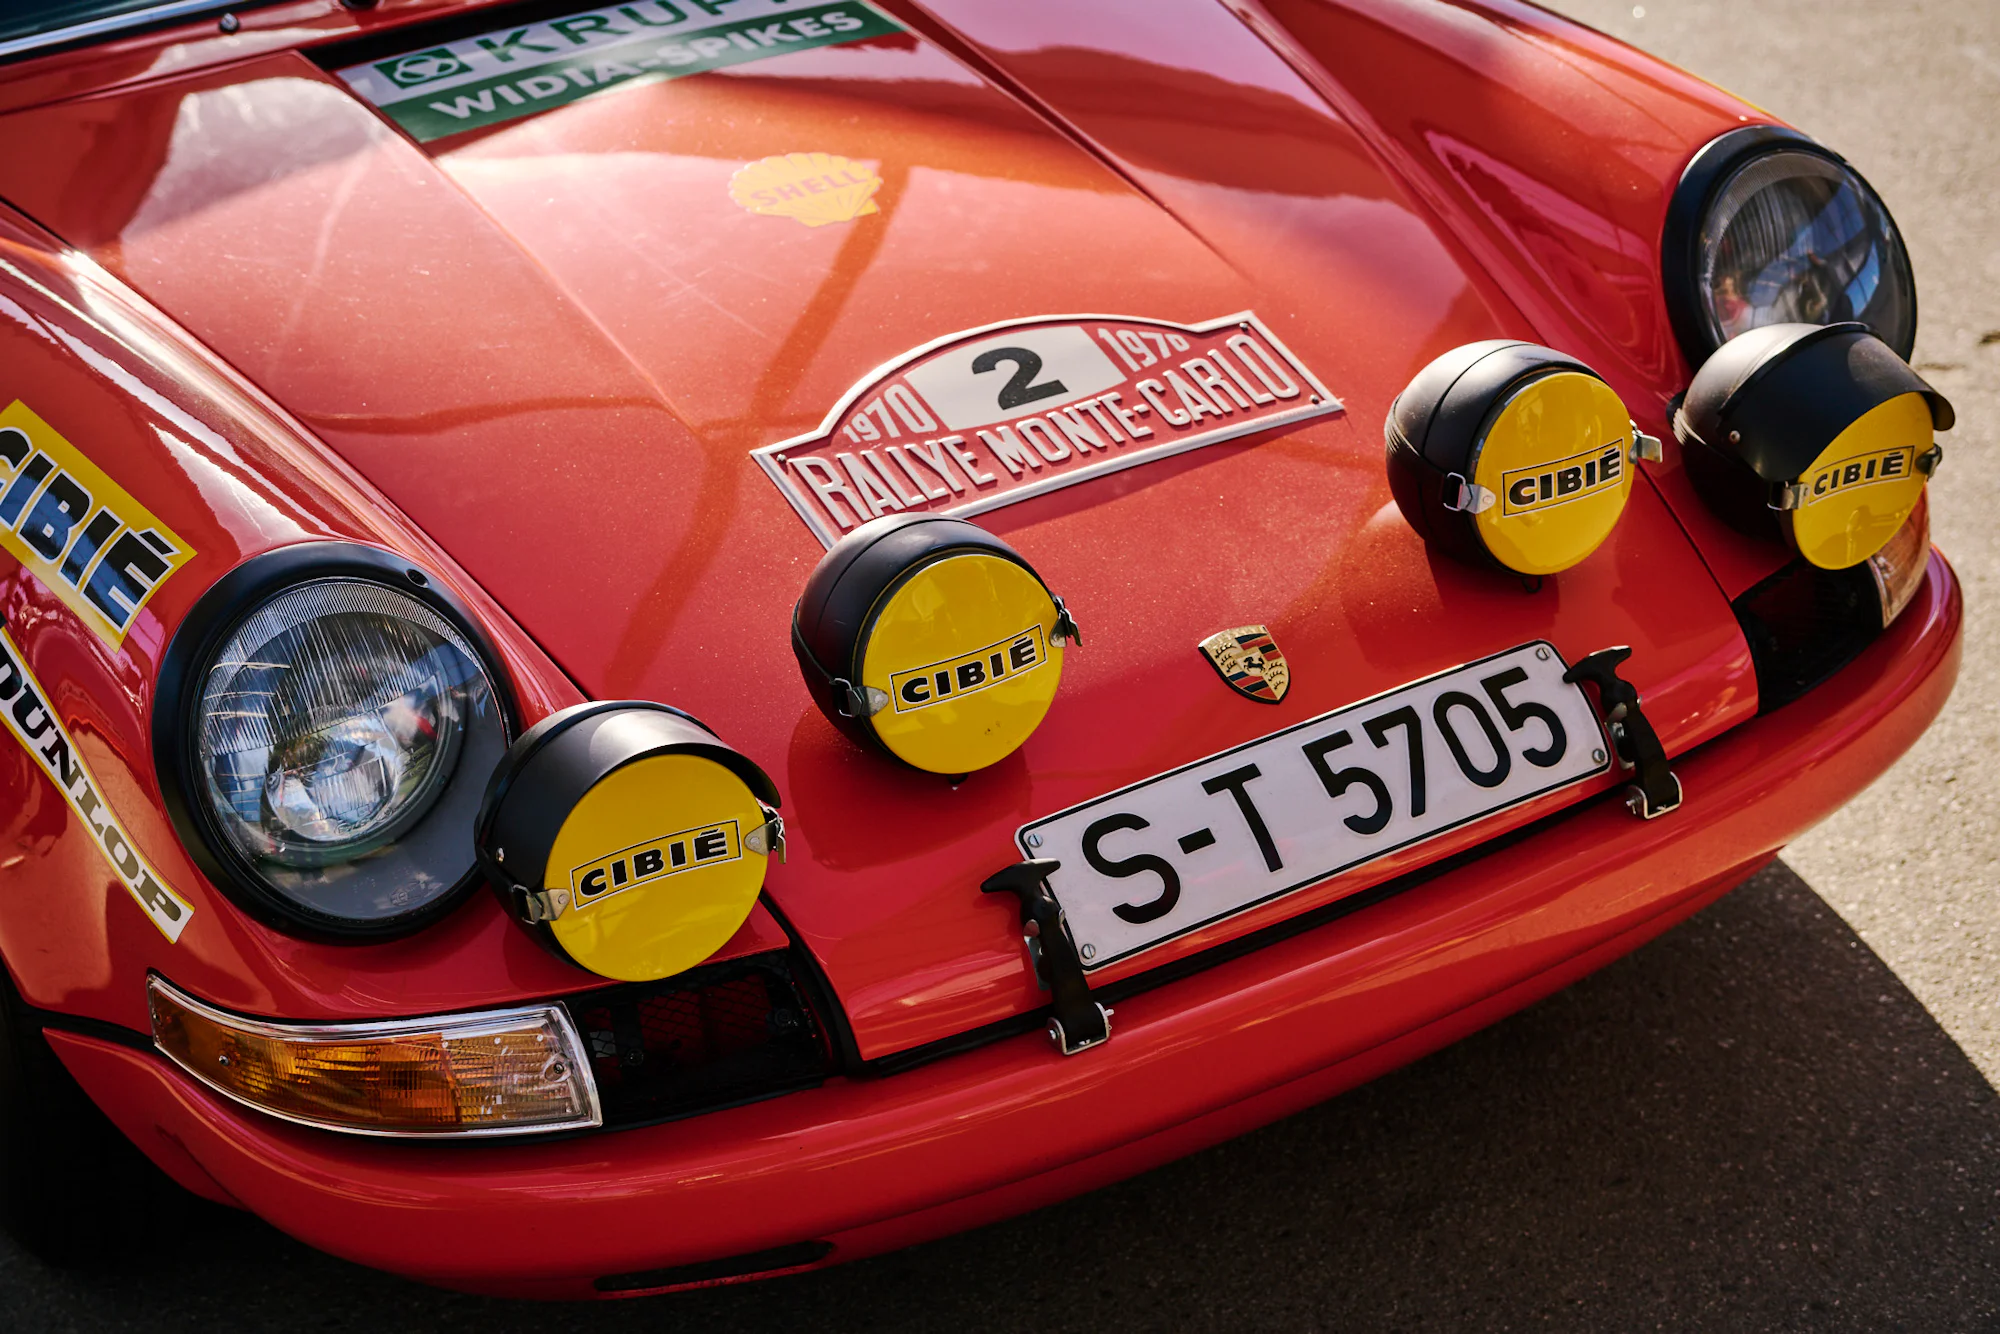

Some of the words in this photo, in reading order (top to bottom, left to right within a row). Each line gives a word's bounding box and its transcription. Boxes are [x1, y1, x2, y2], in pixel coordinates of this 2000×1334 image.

[475, 0, 787, 62] KRUP
[429, 11, 864, 119] WIDIA-SPIKES
[750, 170, 868, 207] SHELL
[971, 346, 1069, 411] 2
[1097, 327, 1190, 373] 1970
[787, 434, 998, 529] RALLYE
[975, 333, 1301, 475] MONTE-CARLO
[842, 383, 939, 443] 1970
[1508, 447, 1622, 507] CIBIÉ
[1812, 451, 1906, 497] CIBIÉ
[900, 636, 1038, 704] CIBIÉ
[1080, 762, 1285, 926] S-T
[1301, 665, 1568, 836] 5705
[578, 827, 729, 897] CIBIÉ
